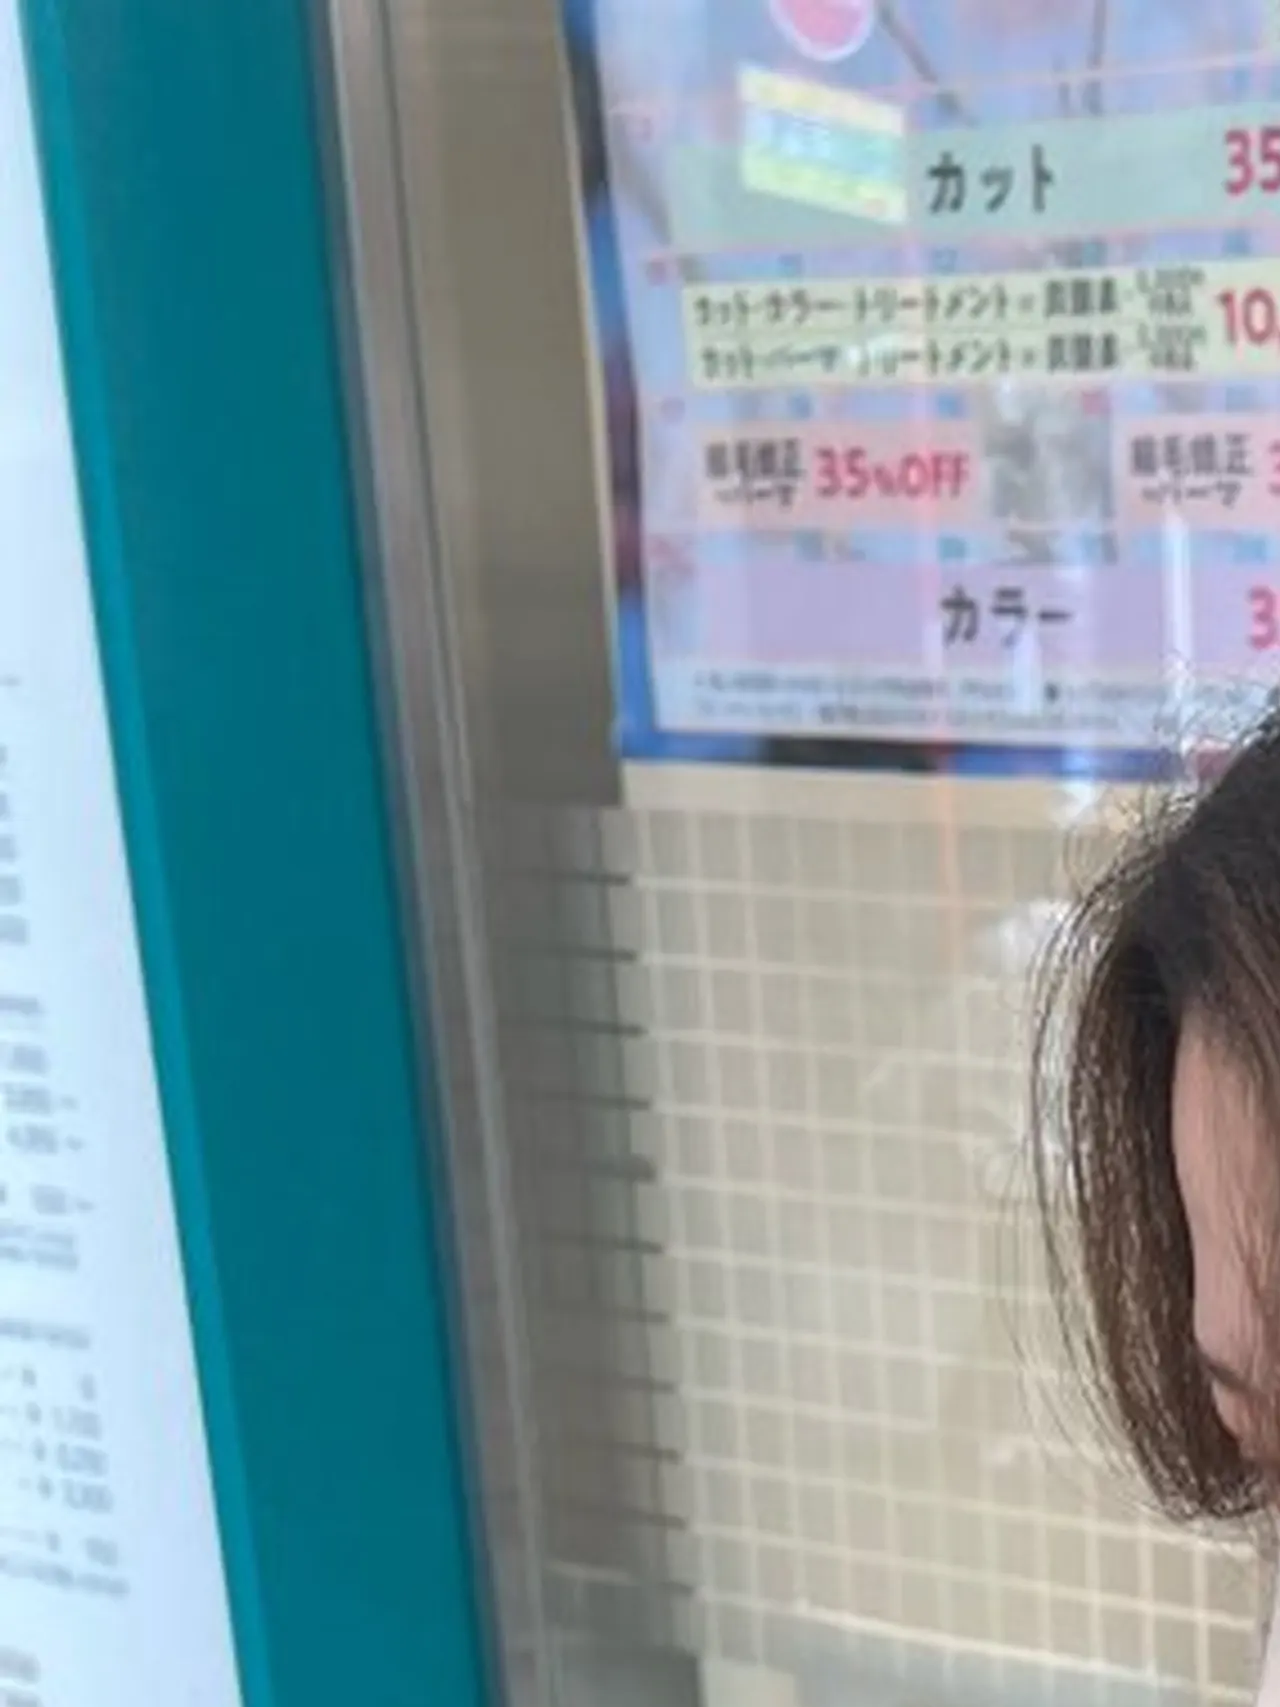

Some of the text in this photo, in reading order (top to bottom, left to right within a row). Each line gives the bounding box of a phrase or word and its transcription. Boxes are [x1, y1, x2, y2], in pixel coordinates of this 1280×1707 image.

[926, 144, 1054, 215] カット
[813, 444, 970, 500] 35%OFF
[939, 583, 1072, 644] カラー
